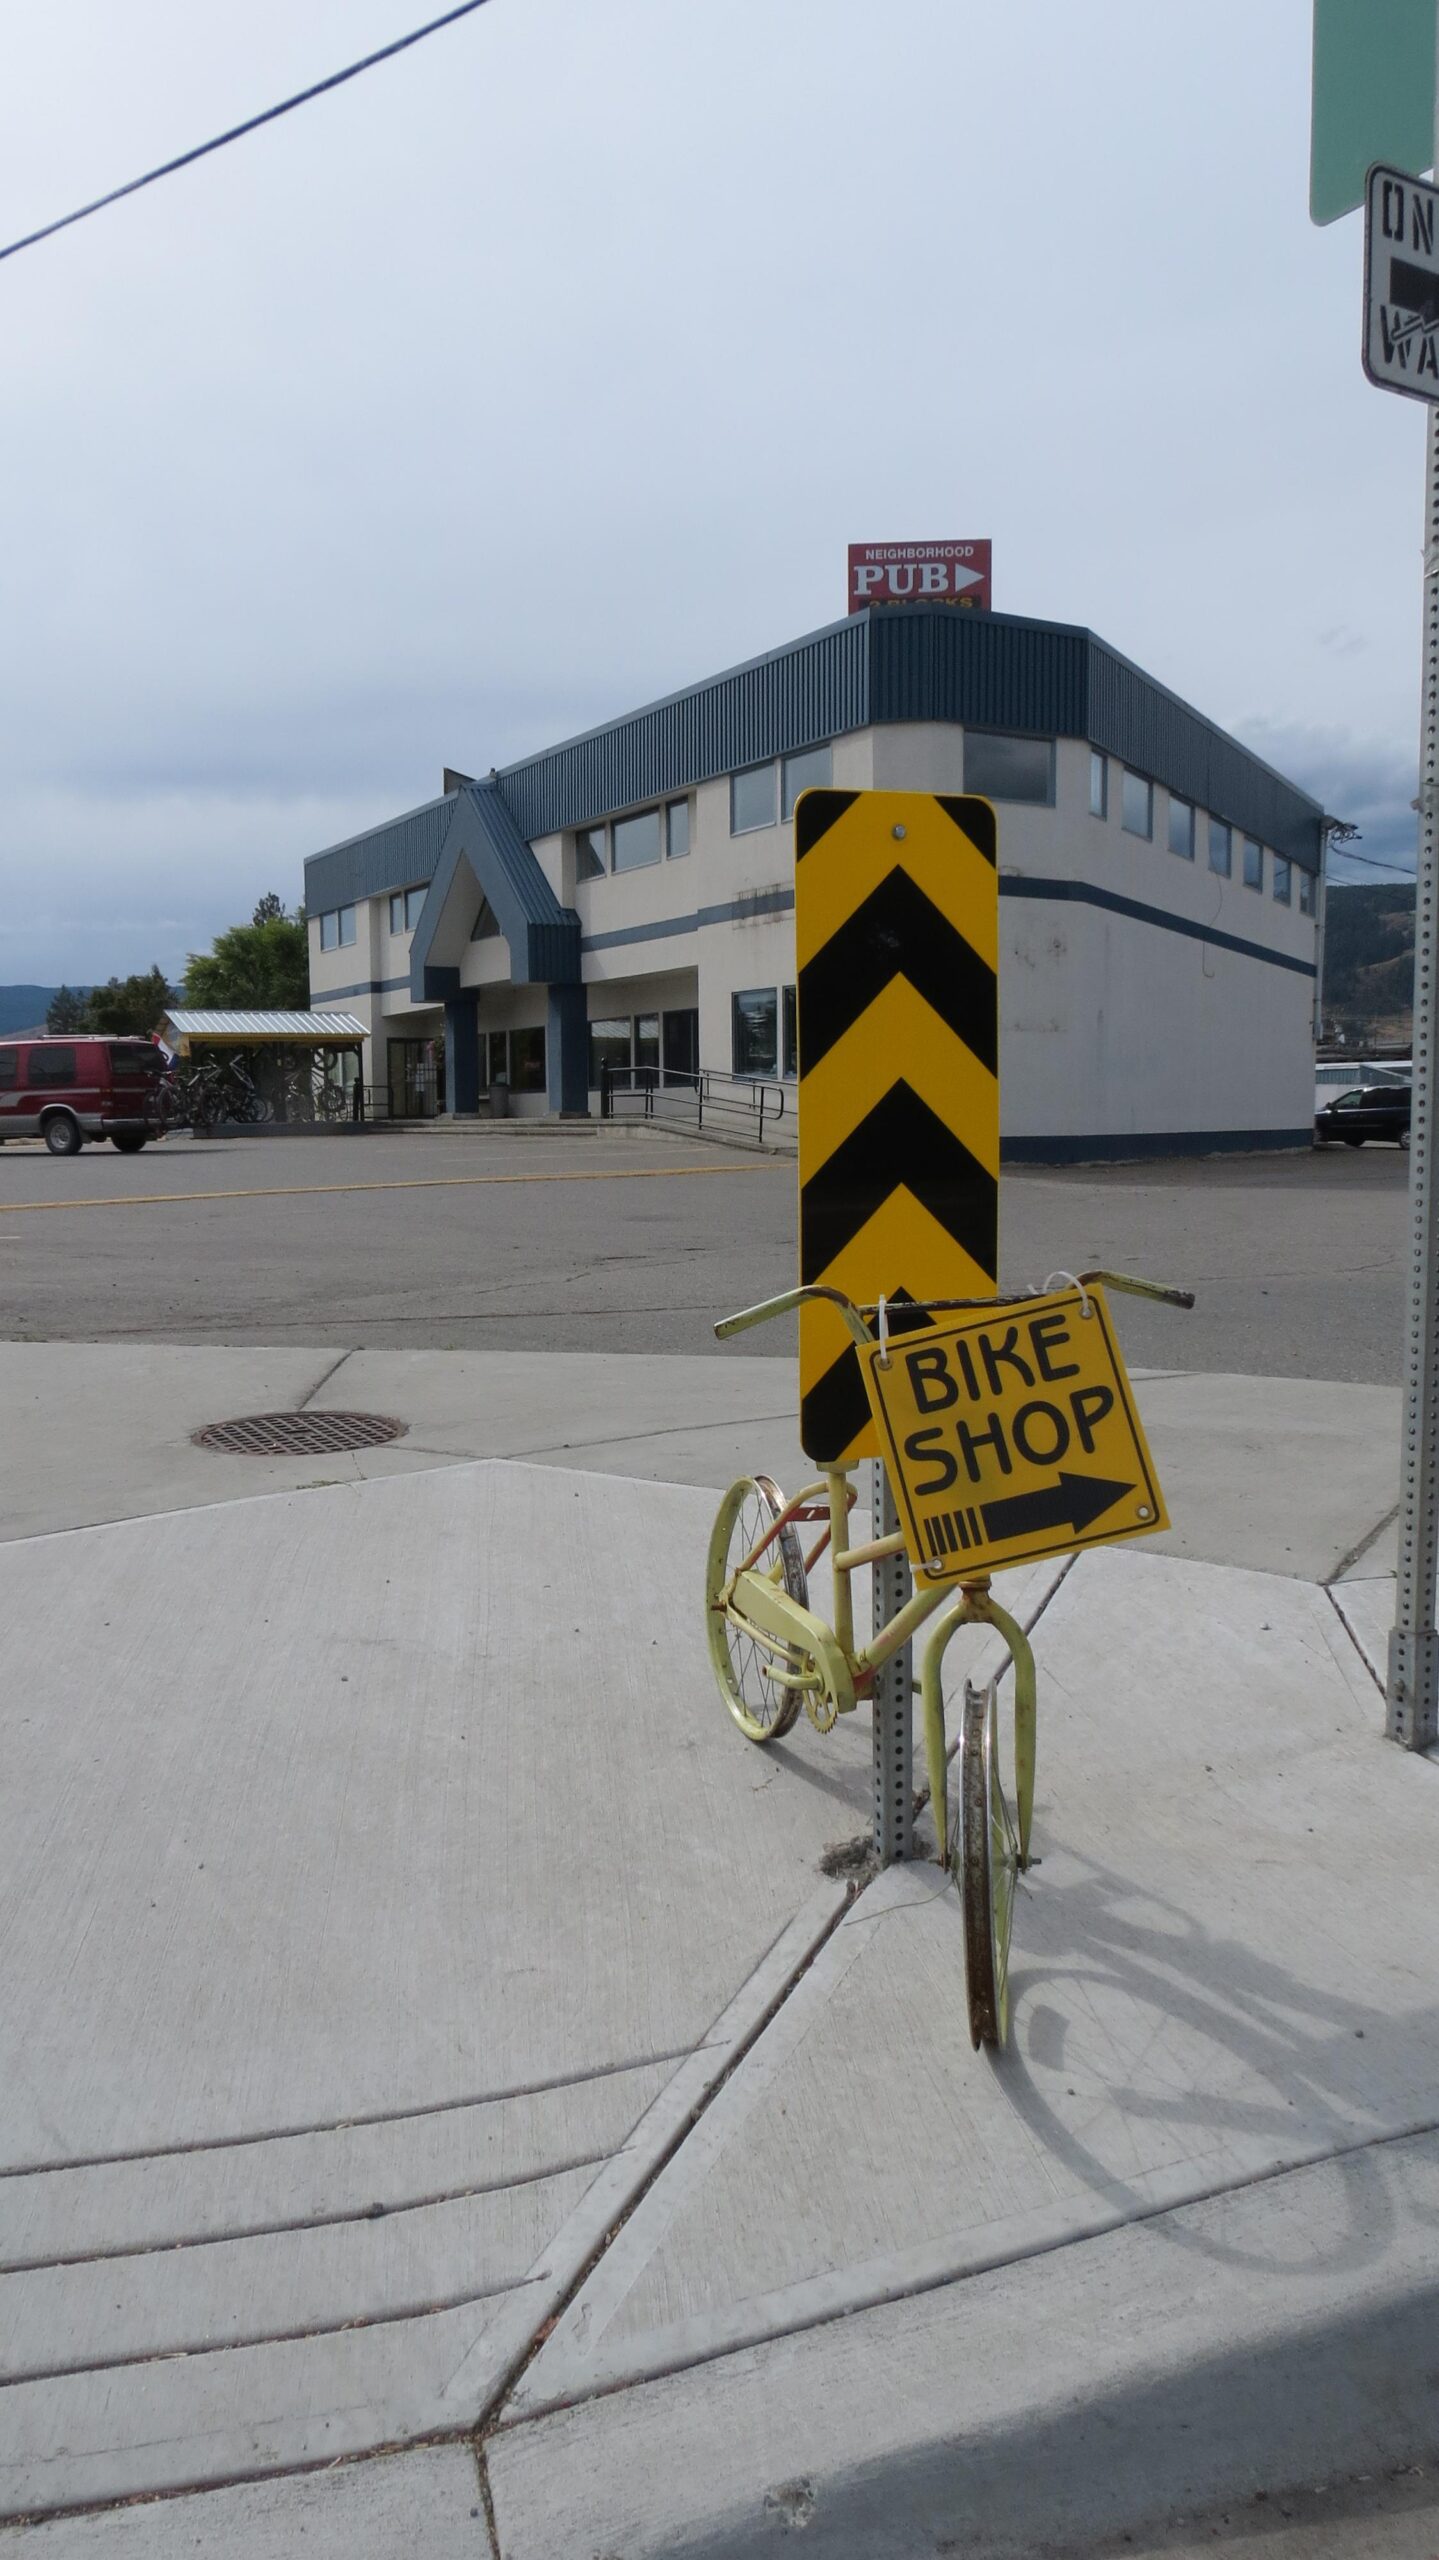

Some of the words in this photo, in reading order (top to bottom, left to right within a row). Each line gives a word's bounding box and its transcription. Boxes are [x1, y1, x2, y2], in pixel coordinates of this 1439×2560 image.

[853, 563, 949, 595] PUB
[865, 546, 974, 560] NEIGHBORHOOD
[905, 1314, 1080, 1414] BIKE
[904, 1385, 1114, 1495] SHOP
